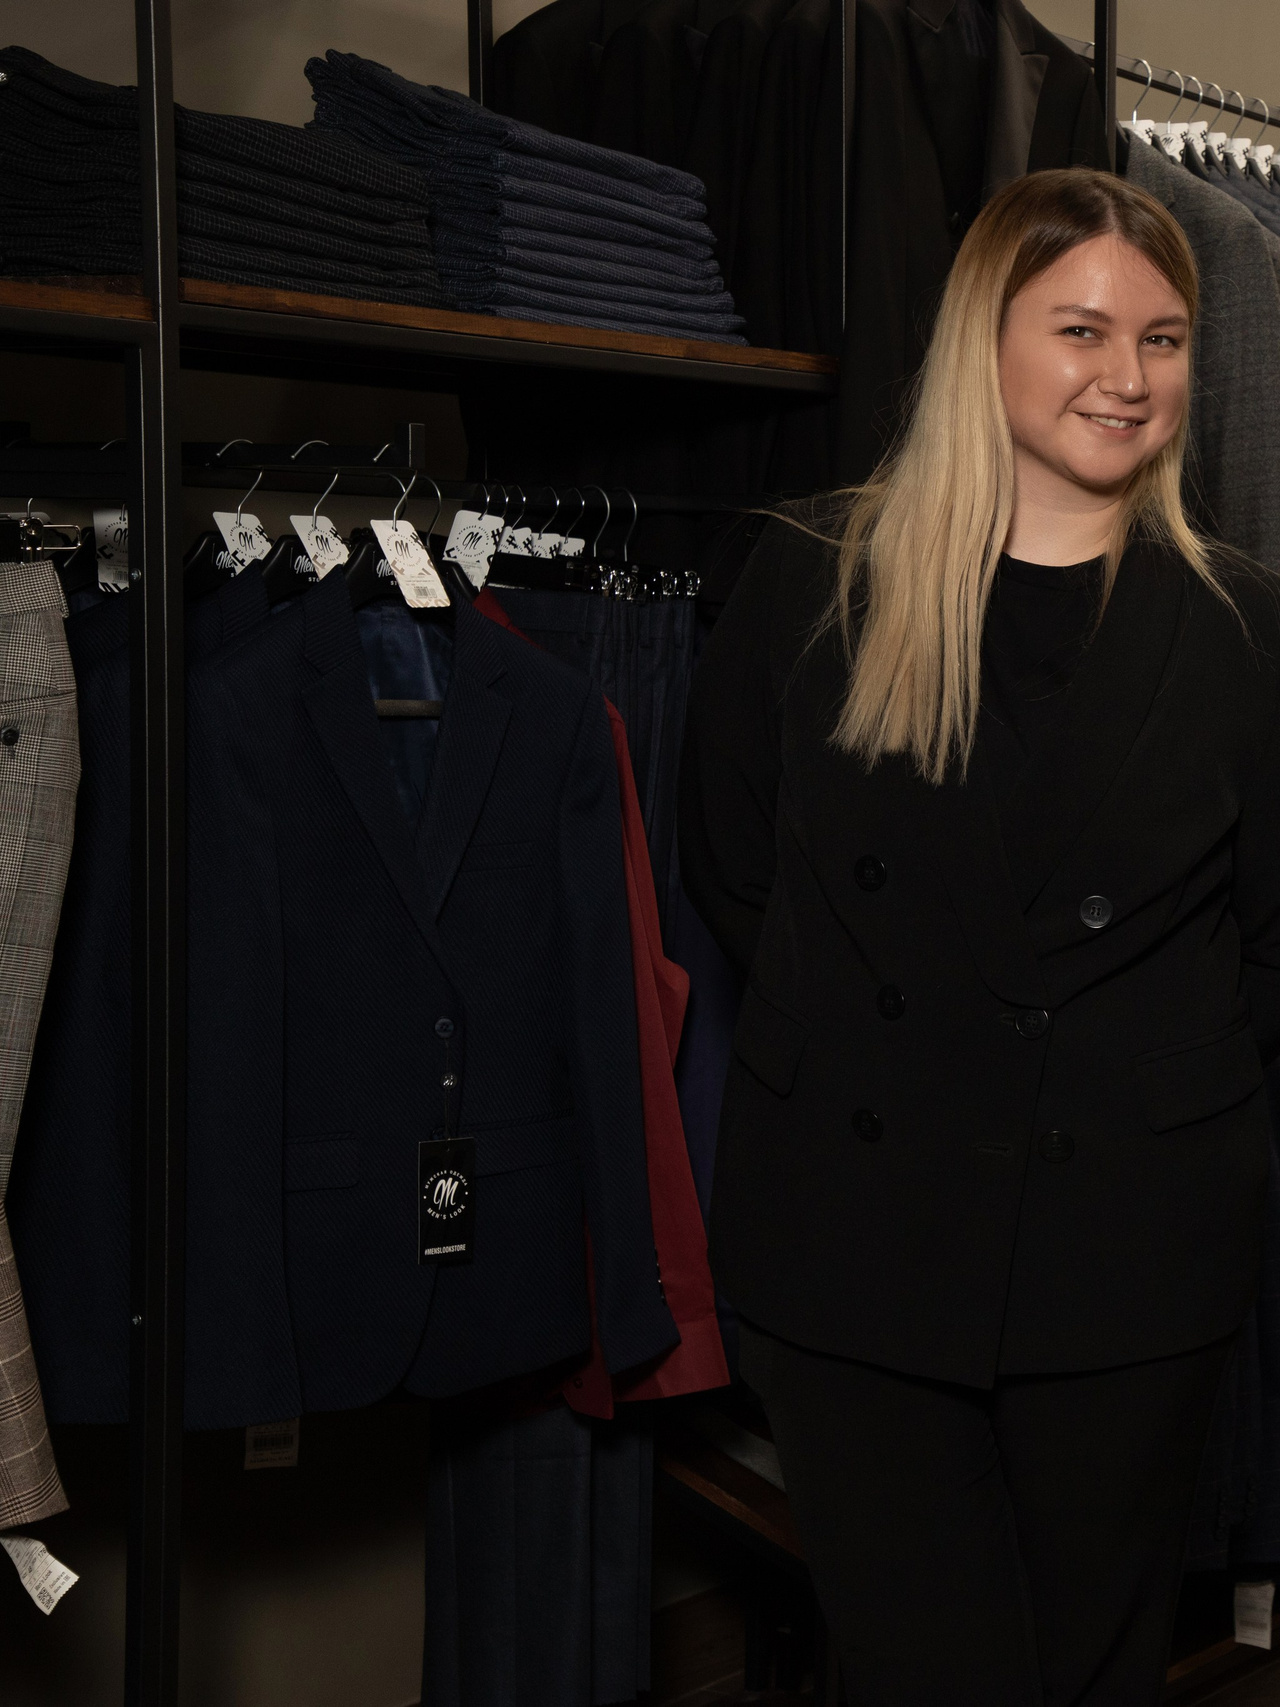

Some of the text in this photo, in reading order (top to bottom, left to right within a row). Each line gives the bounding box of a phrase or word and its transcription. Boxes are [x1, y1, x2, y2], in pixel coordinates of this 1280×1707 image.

[294, 555, 315, 574] Men
[427, 1204, 466, 1220] MEN'S LOOK
[425, 1244, 466, 1256] #MENSLOOKSTORE
